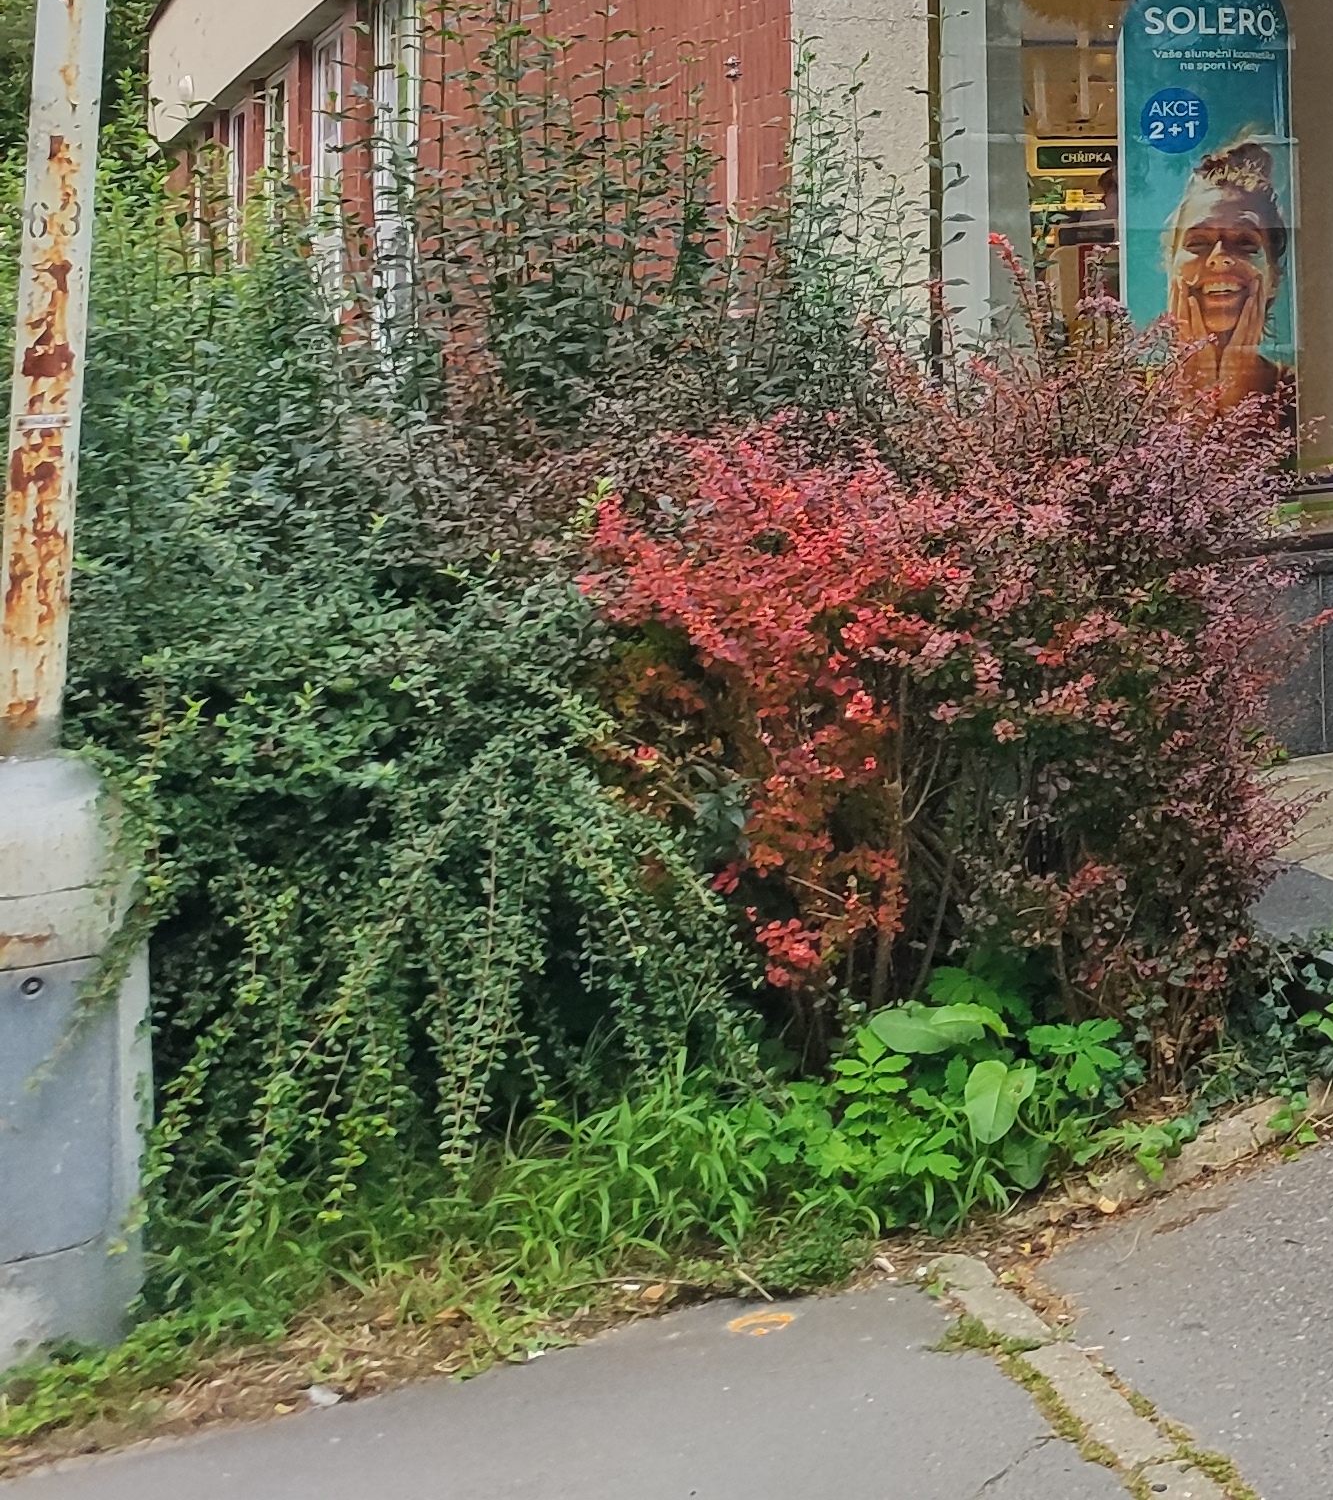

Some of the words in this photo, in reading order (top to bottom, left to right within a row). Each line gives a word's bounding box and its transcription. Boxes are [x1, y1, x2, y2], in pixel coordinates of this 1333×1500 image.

[1144, 6, 1276, 37] SOLERO
[1179, 62, 1195, 70] na
[1196, 61, 1226, 71] sport
[1148, 100, 1200, 117] AKCE
[1060, 150, 1112, 163] CHŘIPKA
